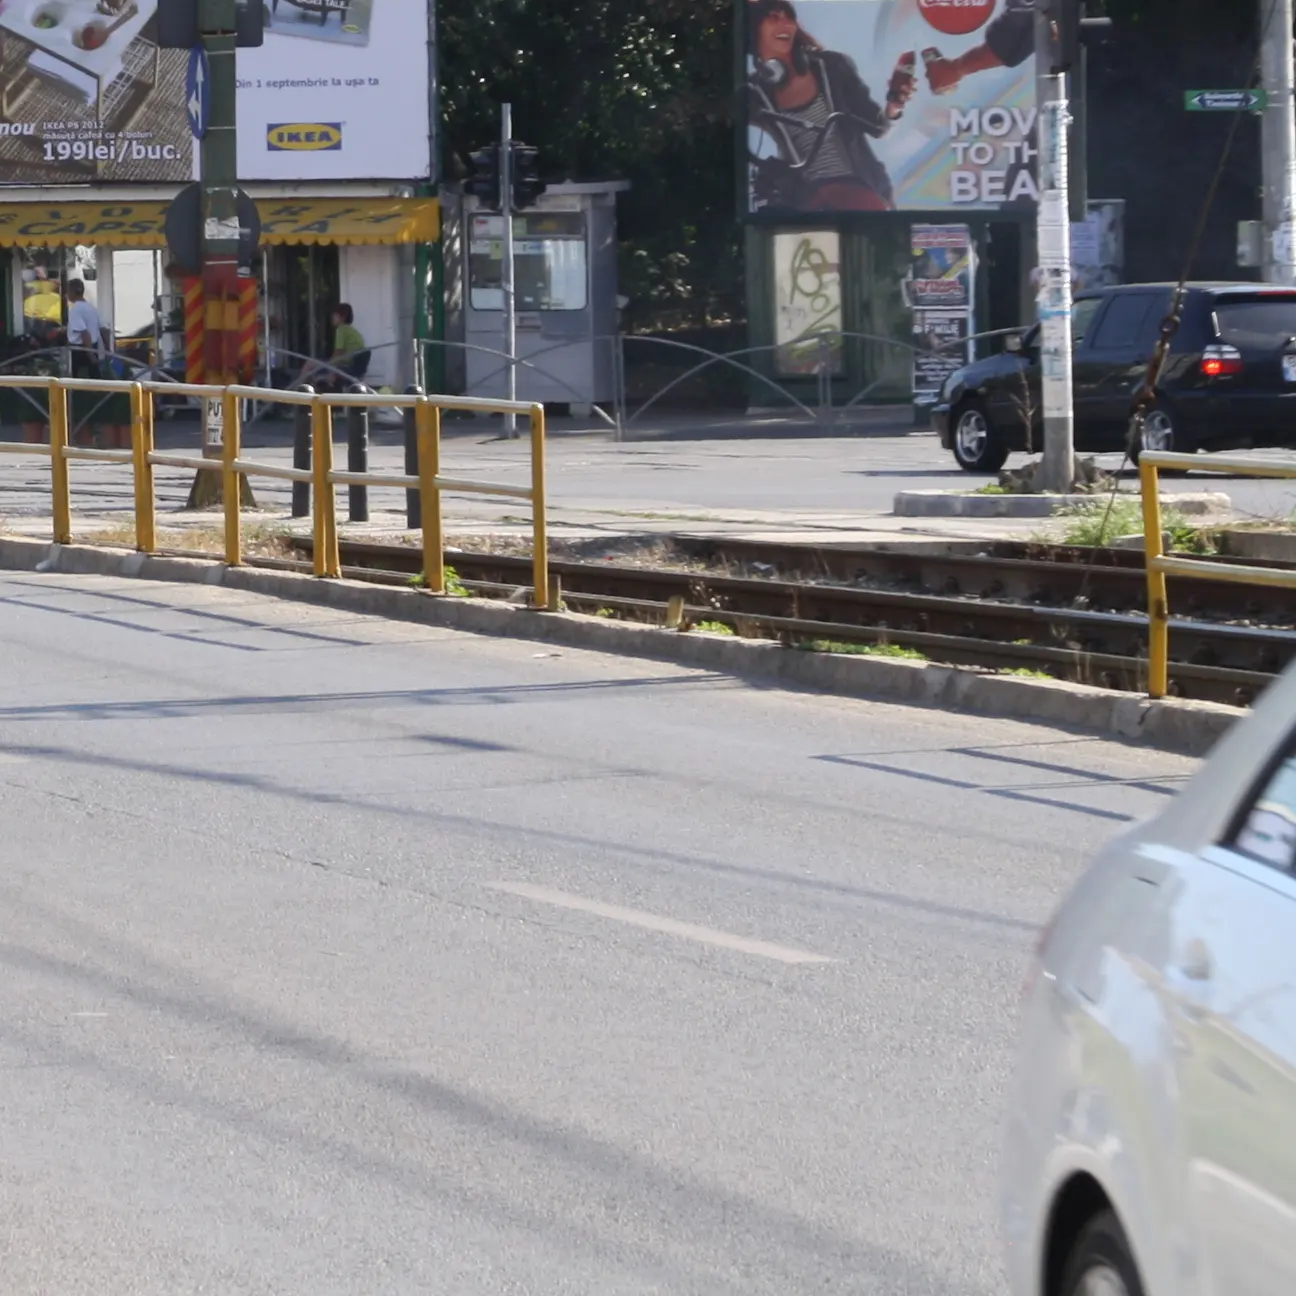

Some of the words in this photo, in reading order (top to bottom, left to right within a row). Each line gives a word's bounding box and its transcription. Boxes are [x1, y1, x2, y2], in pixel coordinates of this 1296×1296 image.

[256, 78, 262, 88] 1
[265, 77, 329, 90] septembrie
[368, 77, 380, 86] ta
[42, 121, 65, 131] IKEA
[67, 121, 80, 130] PS
[82, 120, 105, 130] 2012
[949, 107, 1038, 136] MOV
[105, 132, 116, 140] cu
[275, 131, 334, 144] IKEA
[42, 139, 182, 163] 199lei/buc.
[950, 142, 994, 166] TO
[1002, 141, 1039, 164] TH
[950, 169, 1040, 202] BEA
